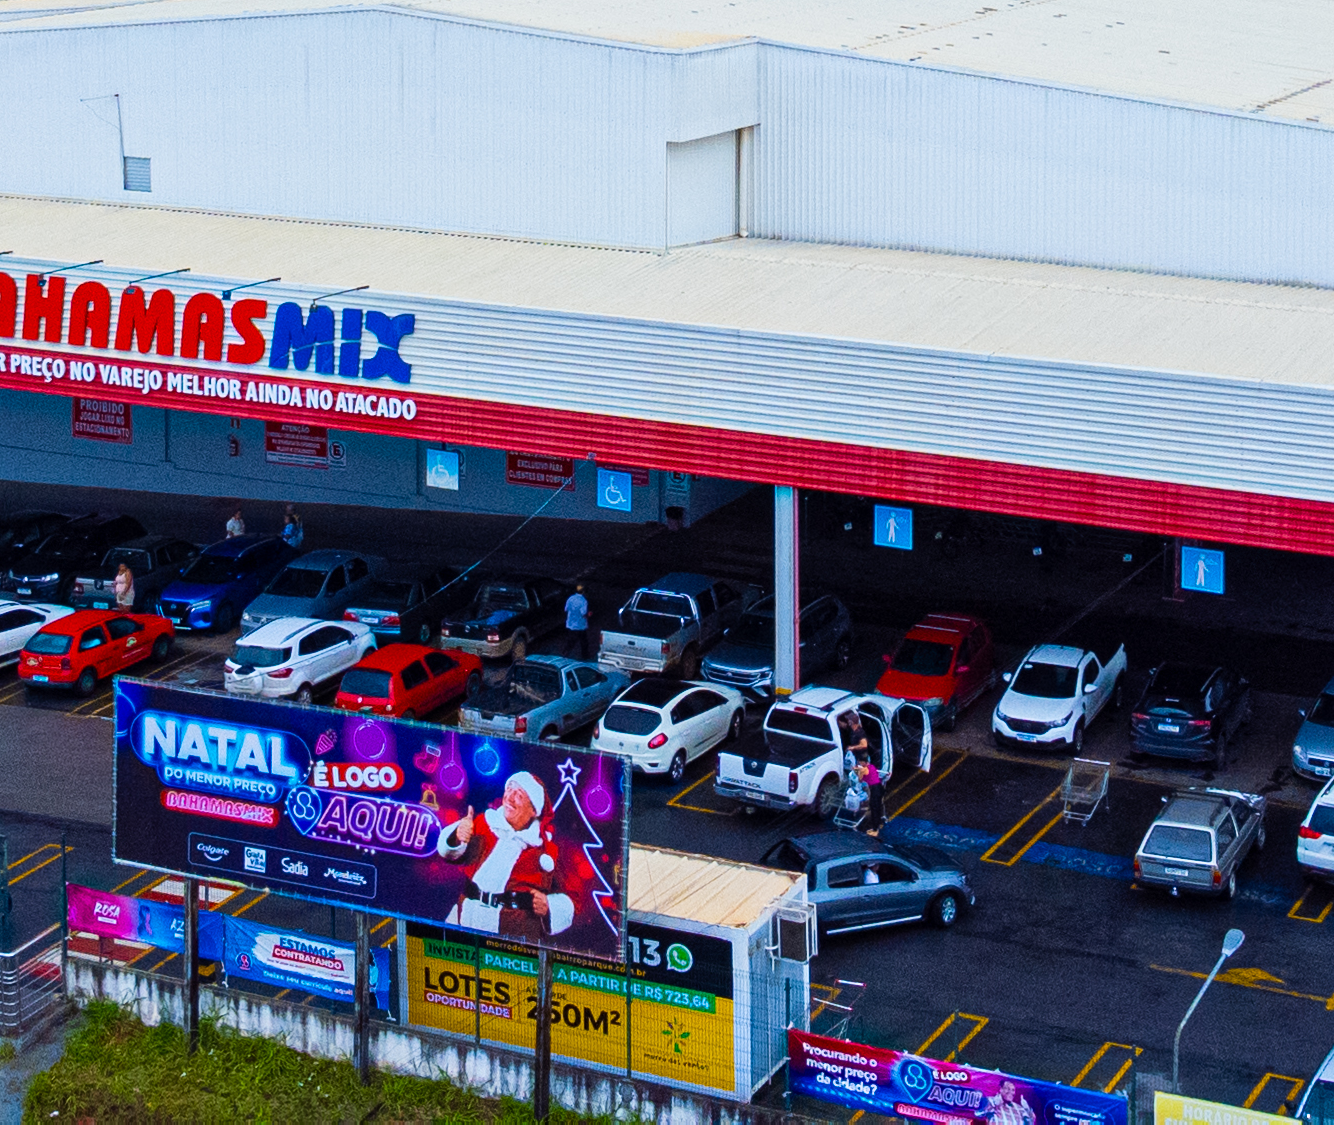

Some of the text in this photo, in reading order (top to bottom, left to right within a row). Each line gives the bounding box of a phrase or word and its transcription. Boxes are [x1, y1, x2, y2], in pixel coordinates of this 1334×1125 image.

[10, 353, 65, 383] PREÇO
[69, 361, 96, 382] NO
[98, 363, 163, 394] VAREJO
[167, 372, 242, 400] MELHOR
[245, 381, 303, 408] AINDA
[306, 389, 333, 410] NO
[335, 391, 417, 420] ATACADO
[80, 399, 124, 414] PROIBIDO
[144, 716, 297, 777] NATAL
[165, 766, 276, 797] DO MENOR PREÇO
[313, 760, 398, 788] É LOGO
[317, 795, 433, 849] AQUI!
[196, 842, 230, 856] Colgate
[281, 857, 309, 876] Sadia
[93, 902, 121, 918] ROSA
[273, 947, 342, 970] CONTRATANDO
[279, 937, 336, 960] ESTAMOS
[428, 941, 478, 961] INVISTA
[629, 936, 661, 967] 13
[424, 966, 511, 1005] LOTES
[557, 969, 568, 981] A
[570, 971, 620, 991] PARTIR
[644, 985, 663, 1002] R$
[666, 989, 710, 1010] 723,64
[426, 992, 511, 1019] OPORTUNDADE
[802, 1041, 878, 1068] Procurando o
[806, 1058, 878, 1083] menor preço
[941, 1071, 968, 1081] LOGO
[816, 1073, 878, 1096] da cidade?
[927, 1085, 983, 1108] AQUI!
